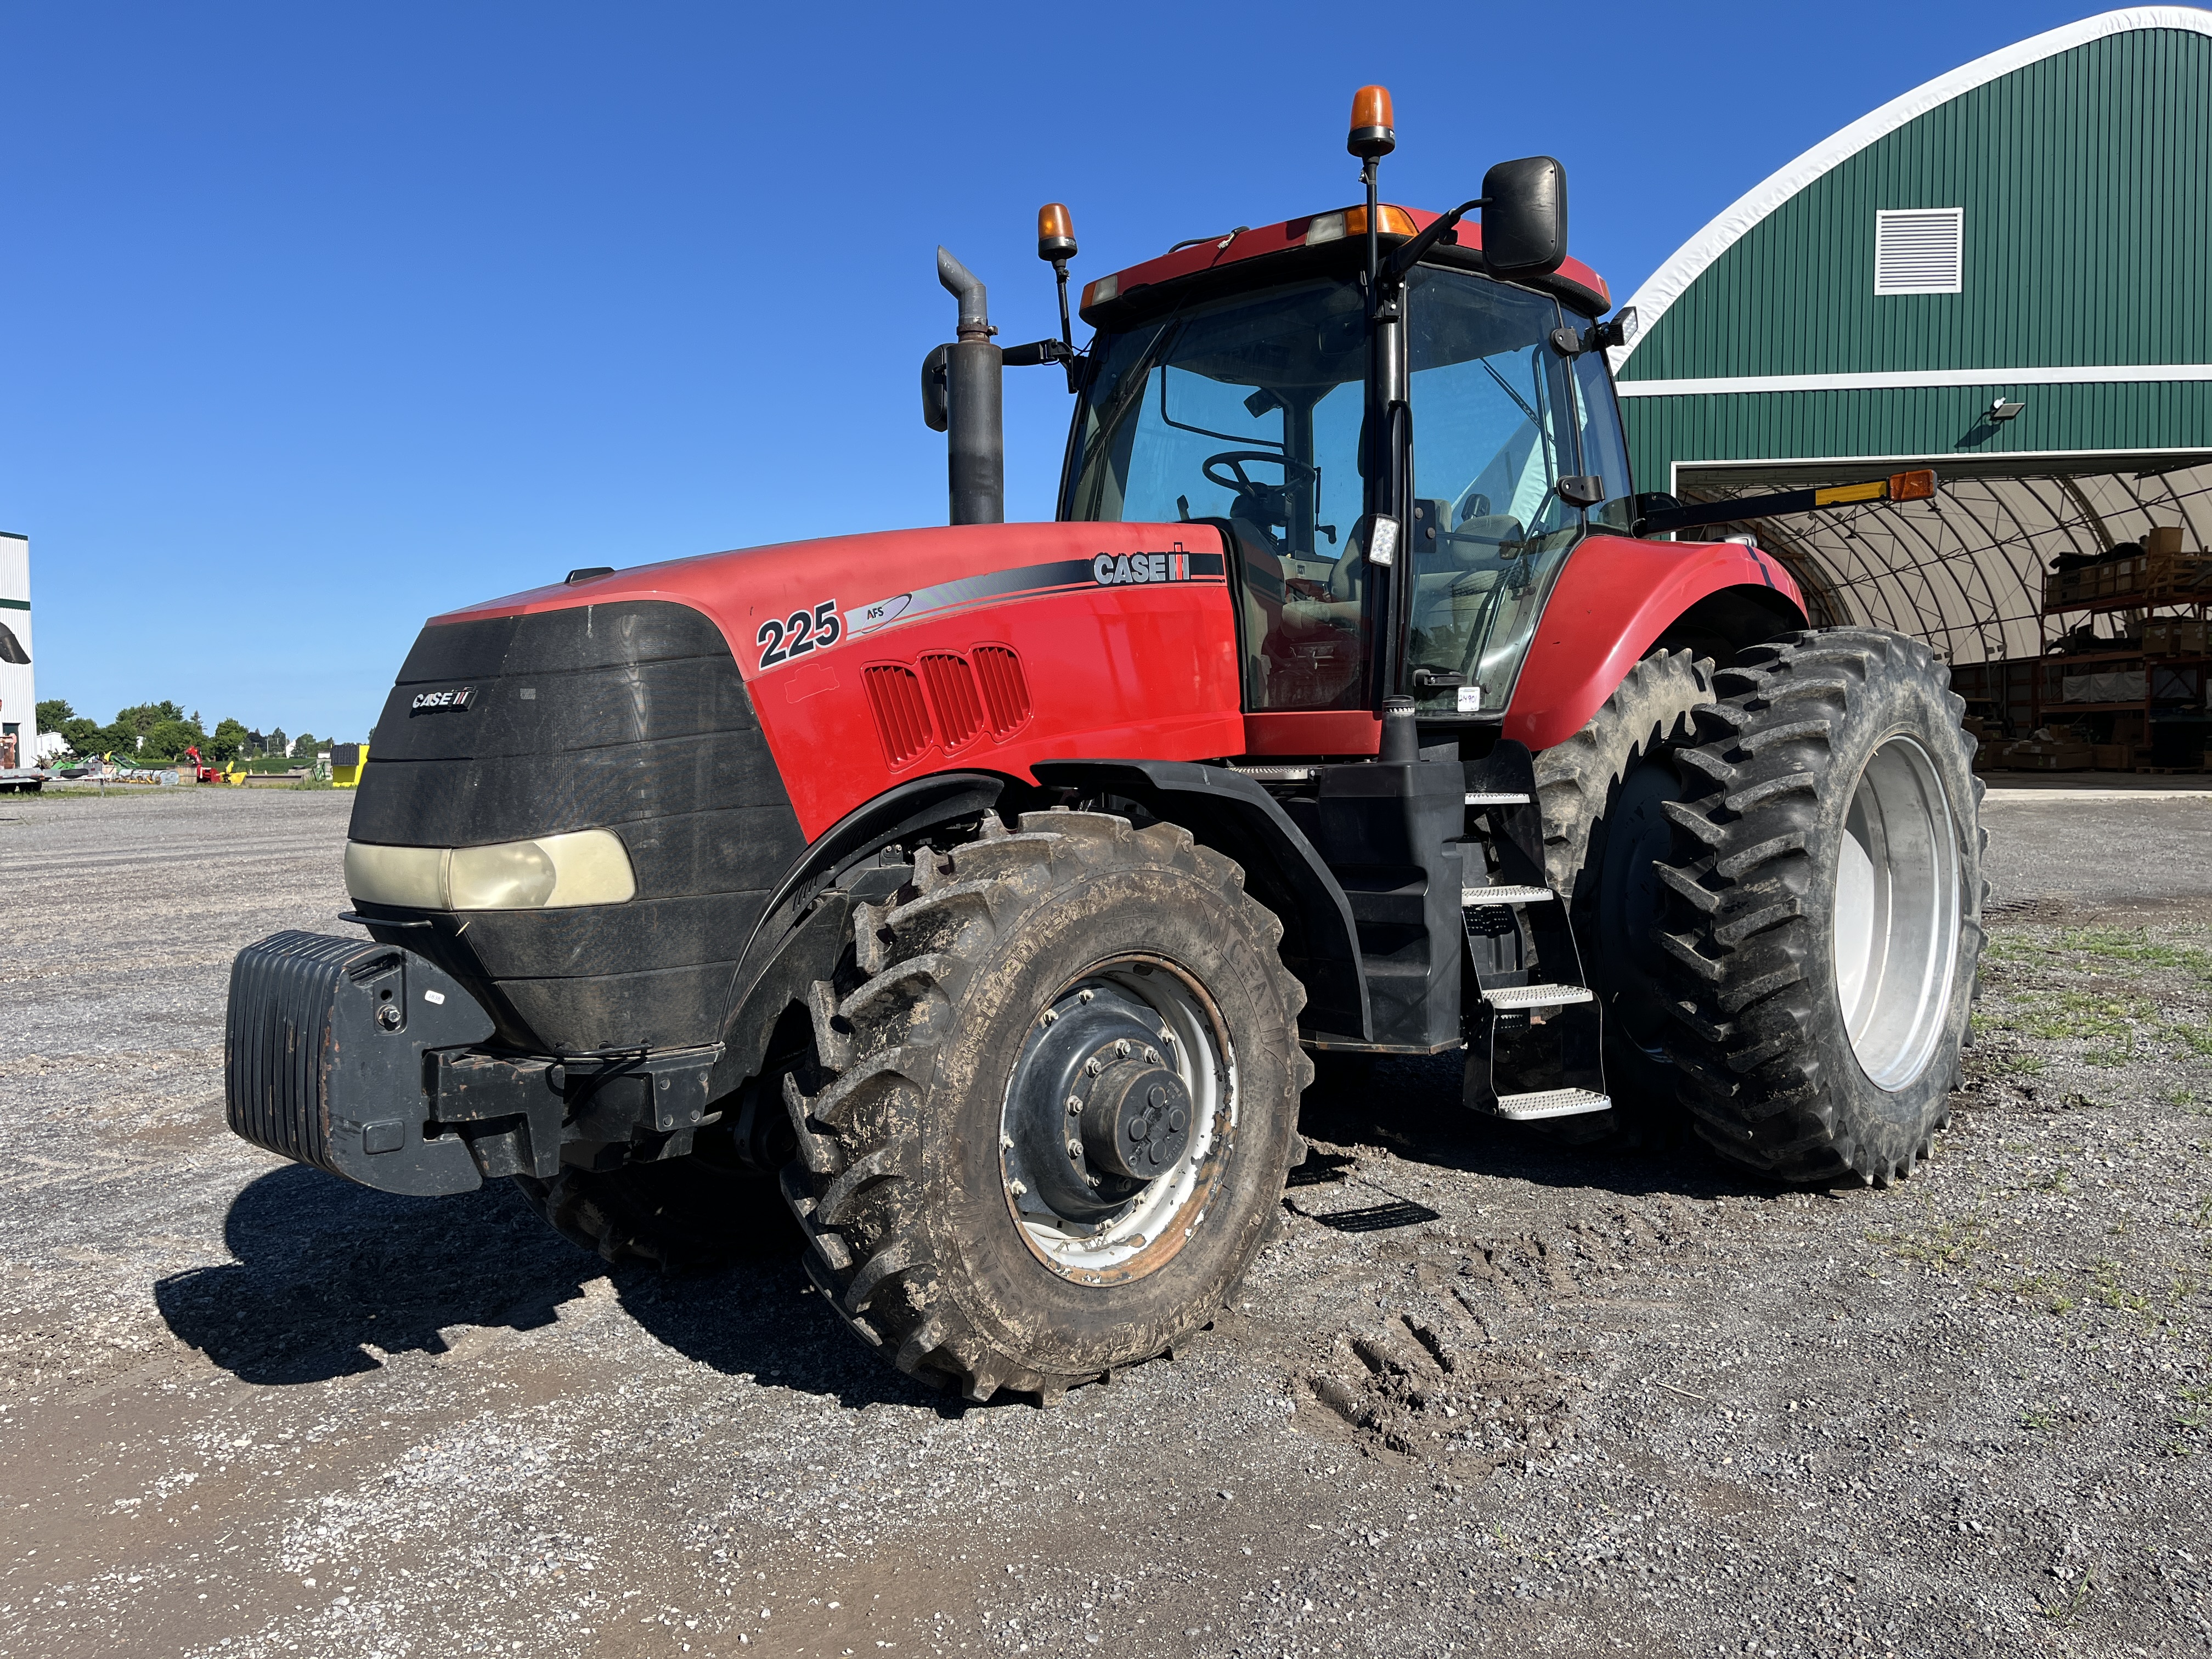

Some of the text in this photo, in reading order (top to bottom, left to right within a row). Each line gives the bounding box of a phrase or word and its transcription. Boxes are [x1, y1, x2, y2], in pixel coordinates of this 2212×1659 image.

[1093, 554, 1166, 584] CASE
[867, 606, 884, 620] AFS
[757, 599, 841, 670] 225
[412, 692, 453, 708] CASE
[1229, 937, 1278, 1021] CEAT
[428, 993, 442, 1001] 1838
